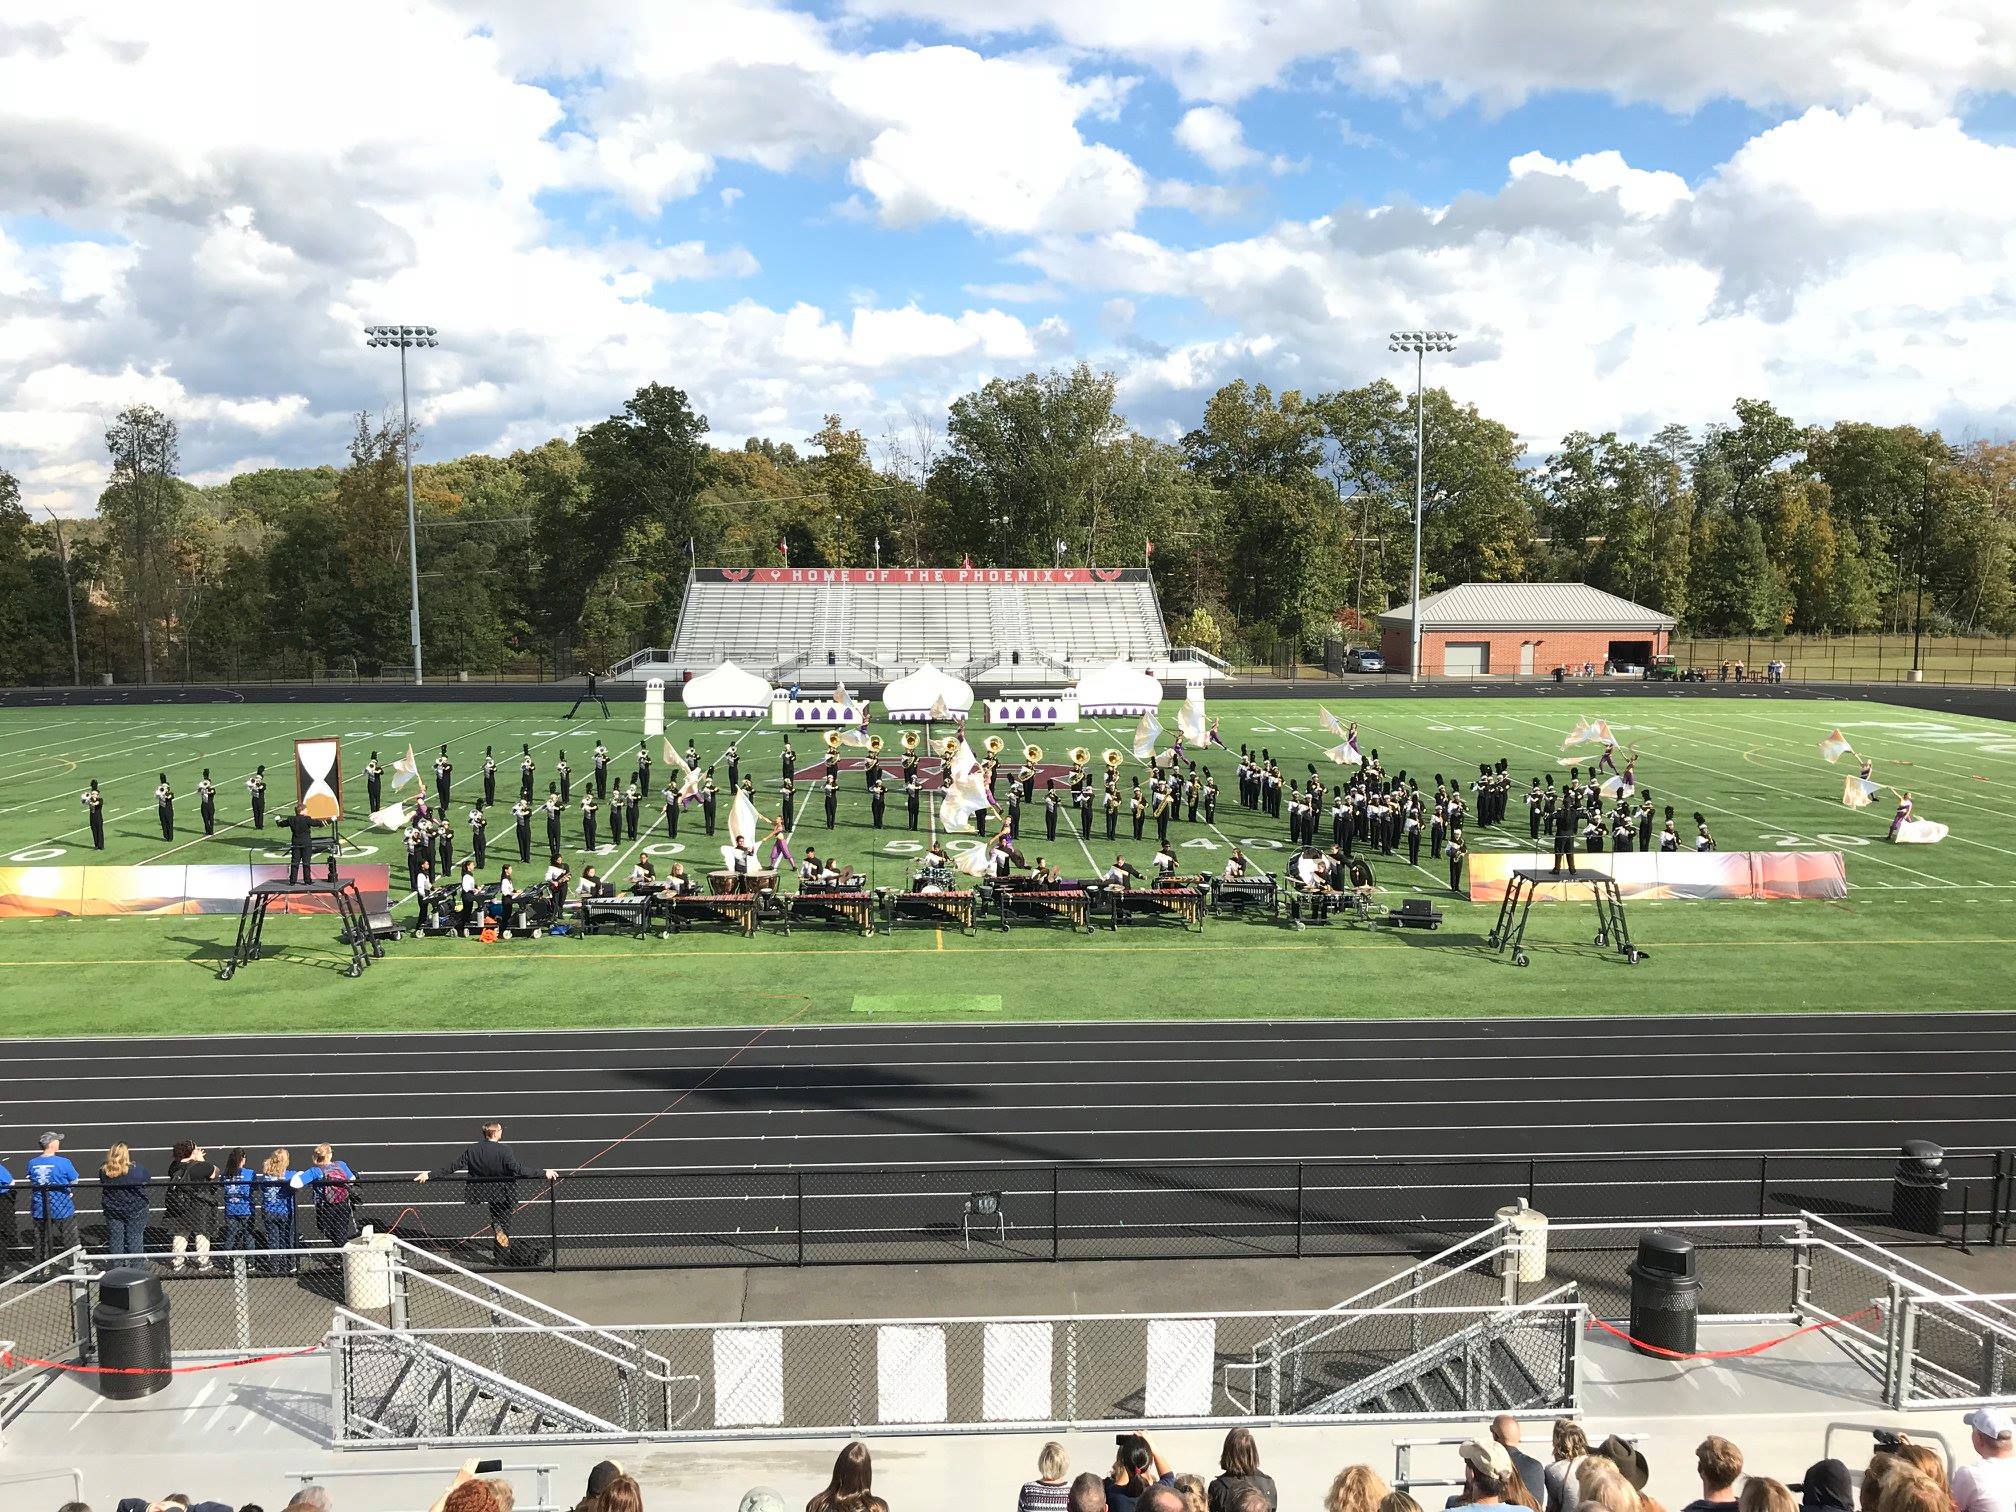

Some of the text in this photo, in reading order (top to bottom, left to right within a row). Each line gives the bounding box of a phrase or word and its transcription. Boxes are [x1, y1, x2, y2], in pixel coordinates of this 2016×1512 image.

[793, 570, 1053, 582] HOME OF THE PHOENIX
[883, 840, 987, 852] 50
[1181, 838, 1284, 849] 40
[1758, 834, 1871, 846] 20
